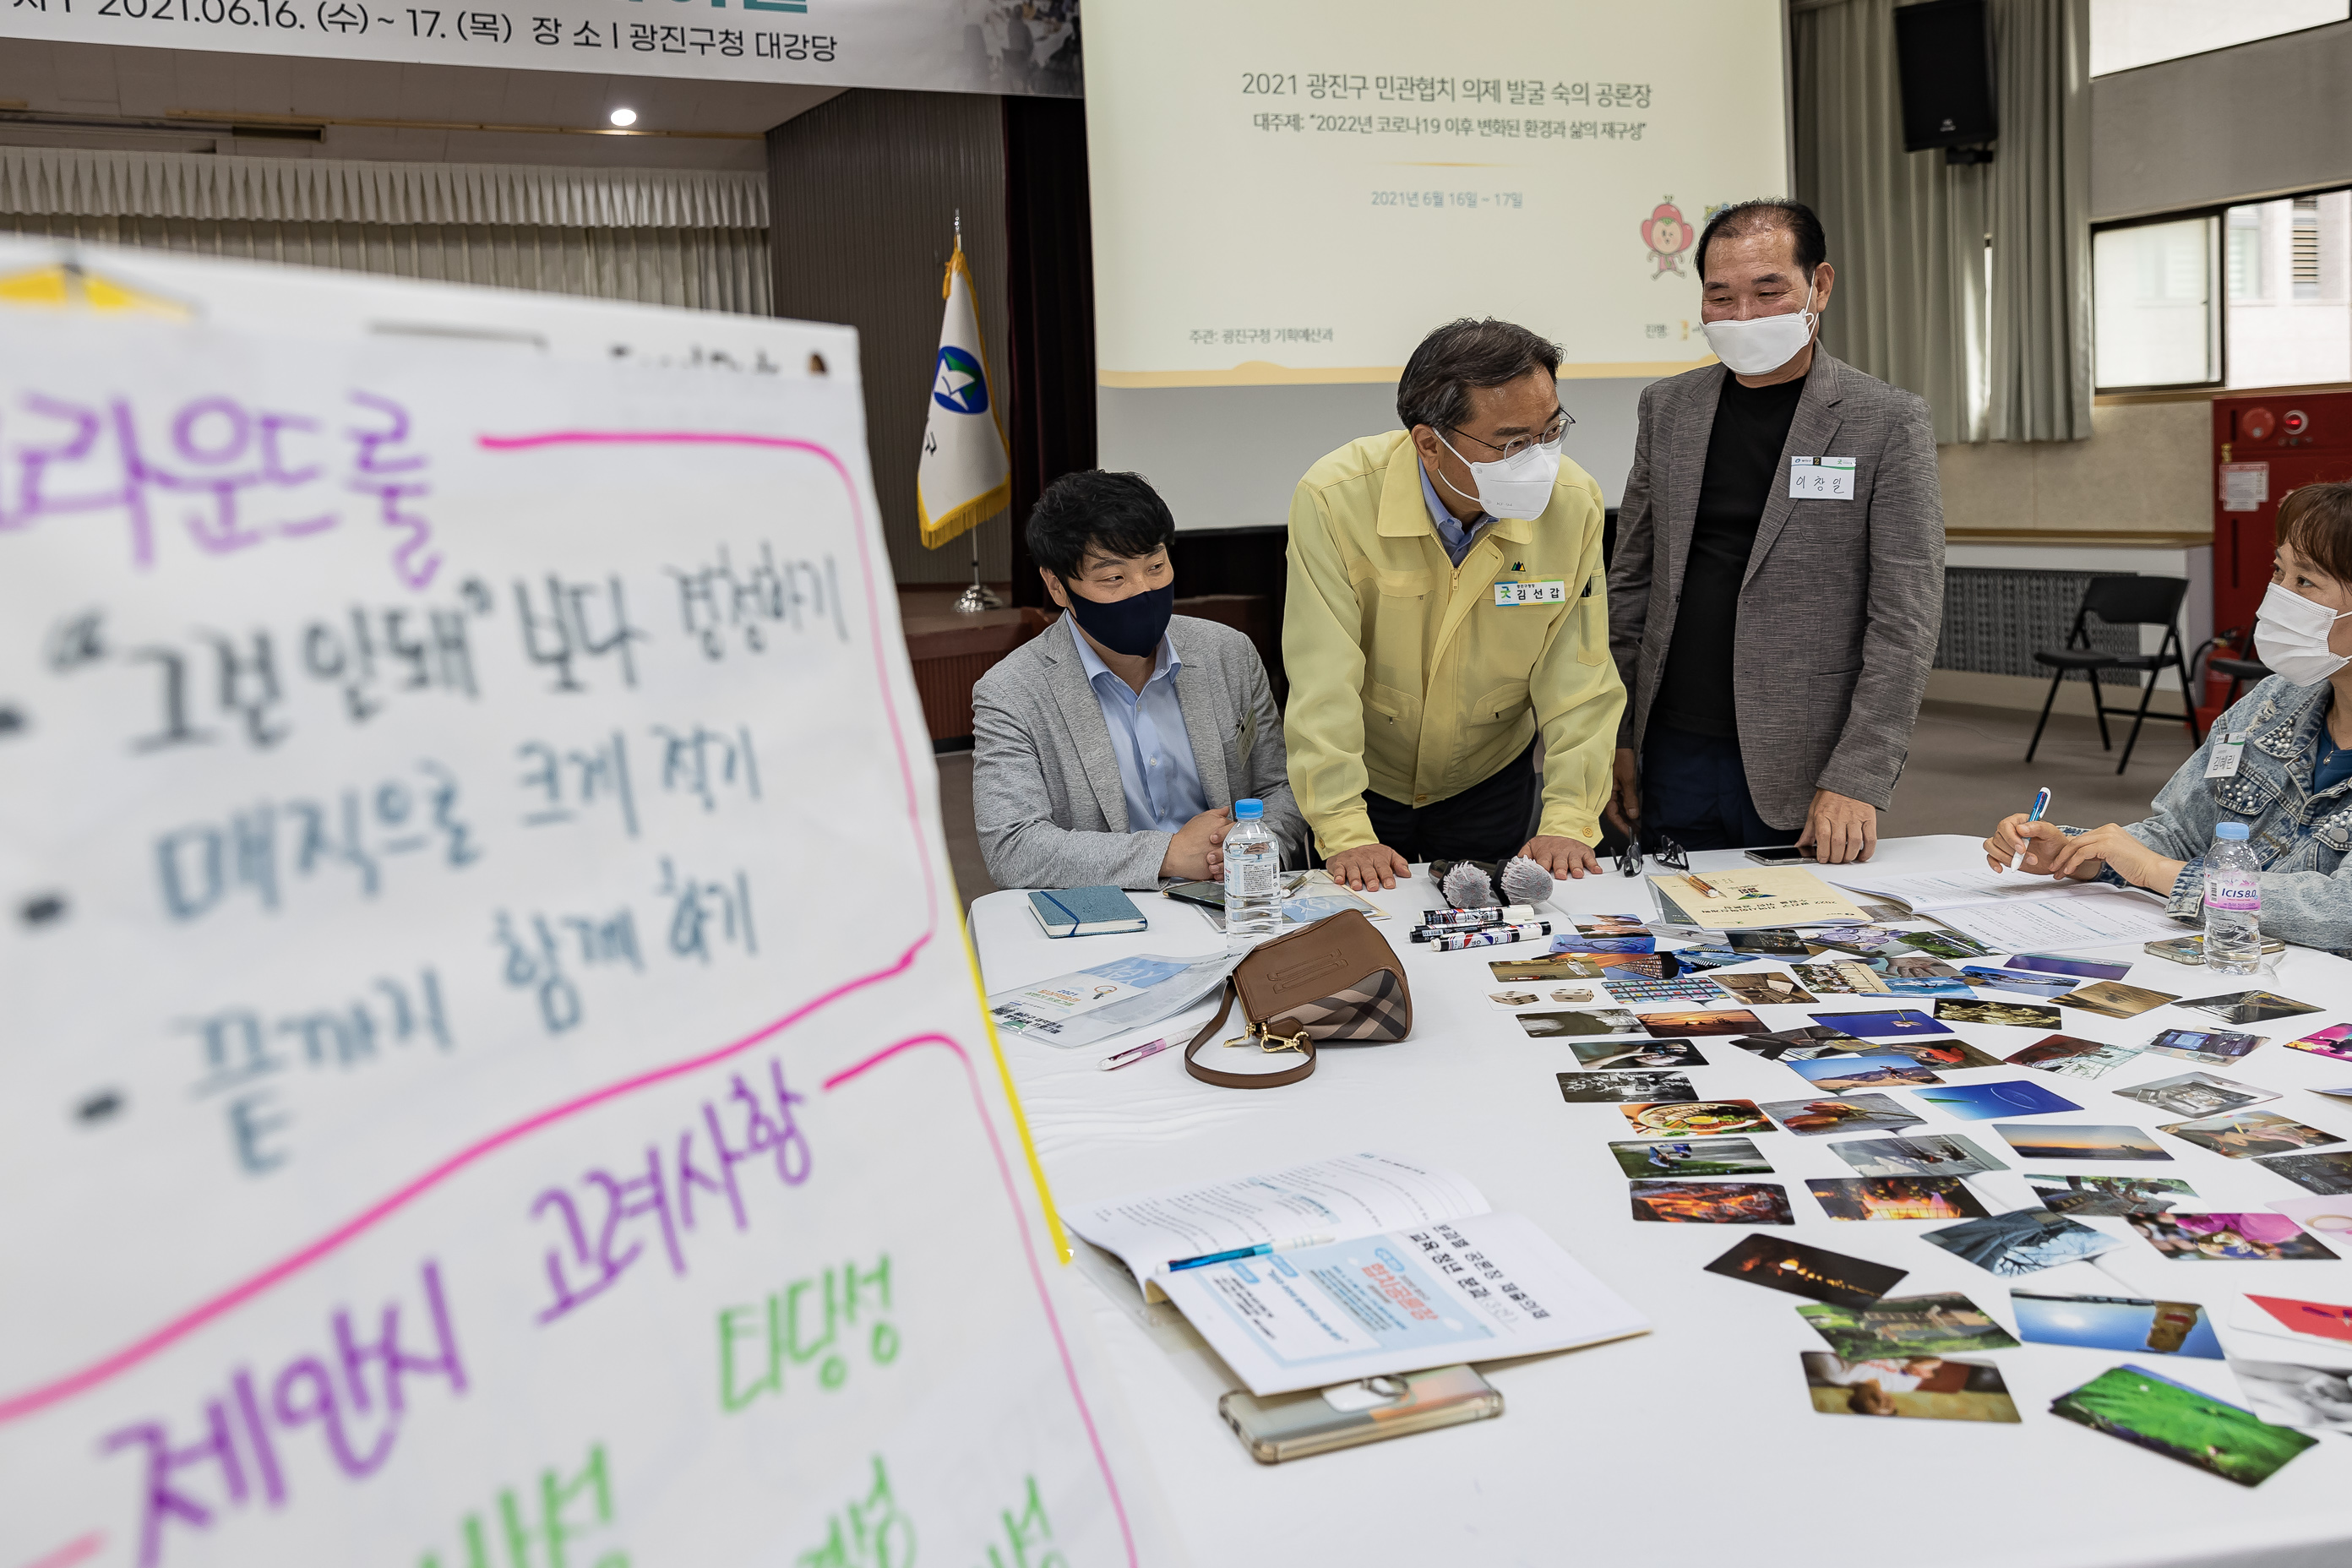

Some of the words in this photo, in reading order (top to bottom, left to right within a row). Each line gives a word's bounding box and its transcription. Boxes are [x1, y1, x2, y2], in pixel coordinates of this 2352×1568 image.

[630, 24, 743, 57] 광진구청
[756, 32, 837, 62] 대강당
[1243, 74, 1296, 94] 2021
[1307, 74, 1369, 99] 광진구
[1376, 76, 1455, 101] 민관협치
[1463, 79, 1500, 102] 의제
[1507, 81, 1545, 105] 발굴
[1551, 83, 1589, 106] 숙의
[1596, 84, 1651, 108] 공론장
[1254, 113, 1304, 132] 대주제:
[1378, 117, 1440, 134] 코로나19
[1445, 118, 1473, 135] 이후
[1478, 117, 1520, 137] 변화된
[1523, 120, 1565, 140] 환경과
[1571, 122, 1597, 139] 삶의
[1372, 191, 1418, 207] 2021년
[1424, 192, 1443, 207] 6월
[1450, 192, 1477, 208] 16일
[1494, 193, 1522, 209] 17일
[1222, 329, 1270, 344] 광진구청
